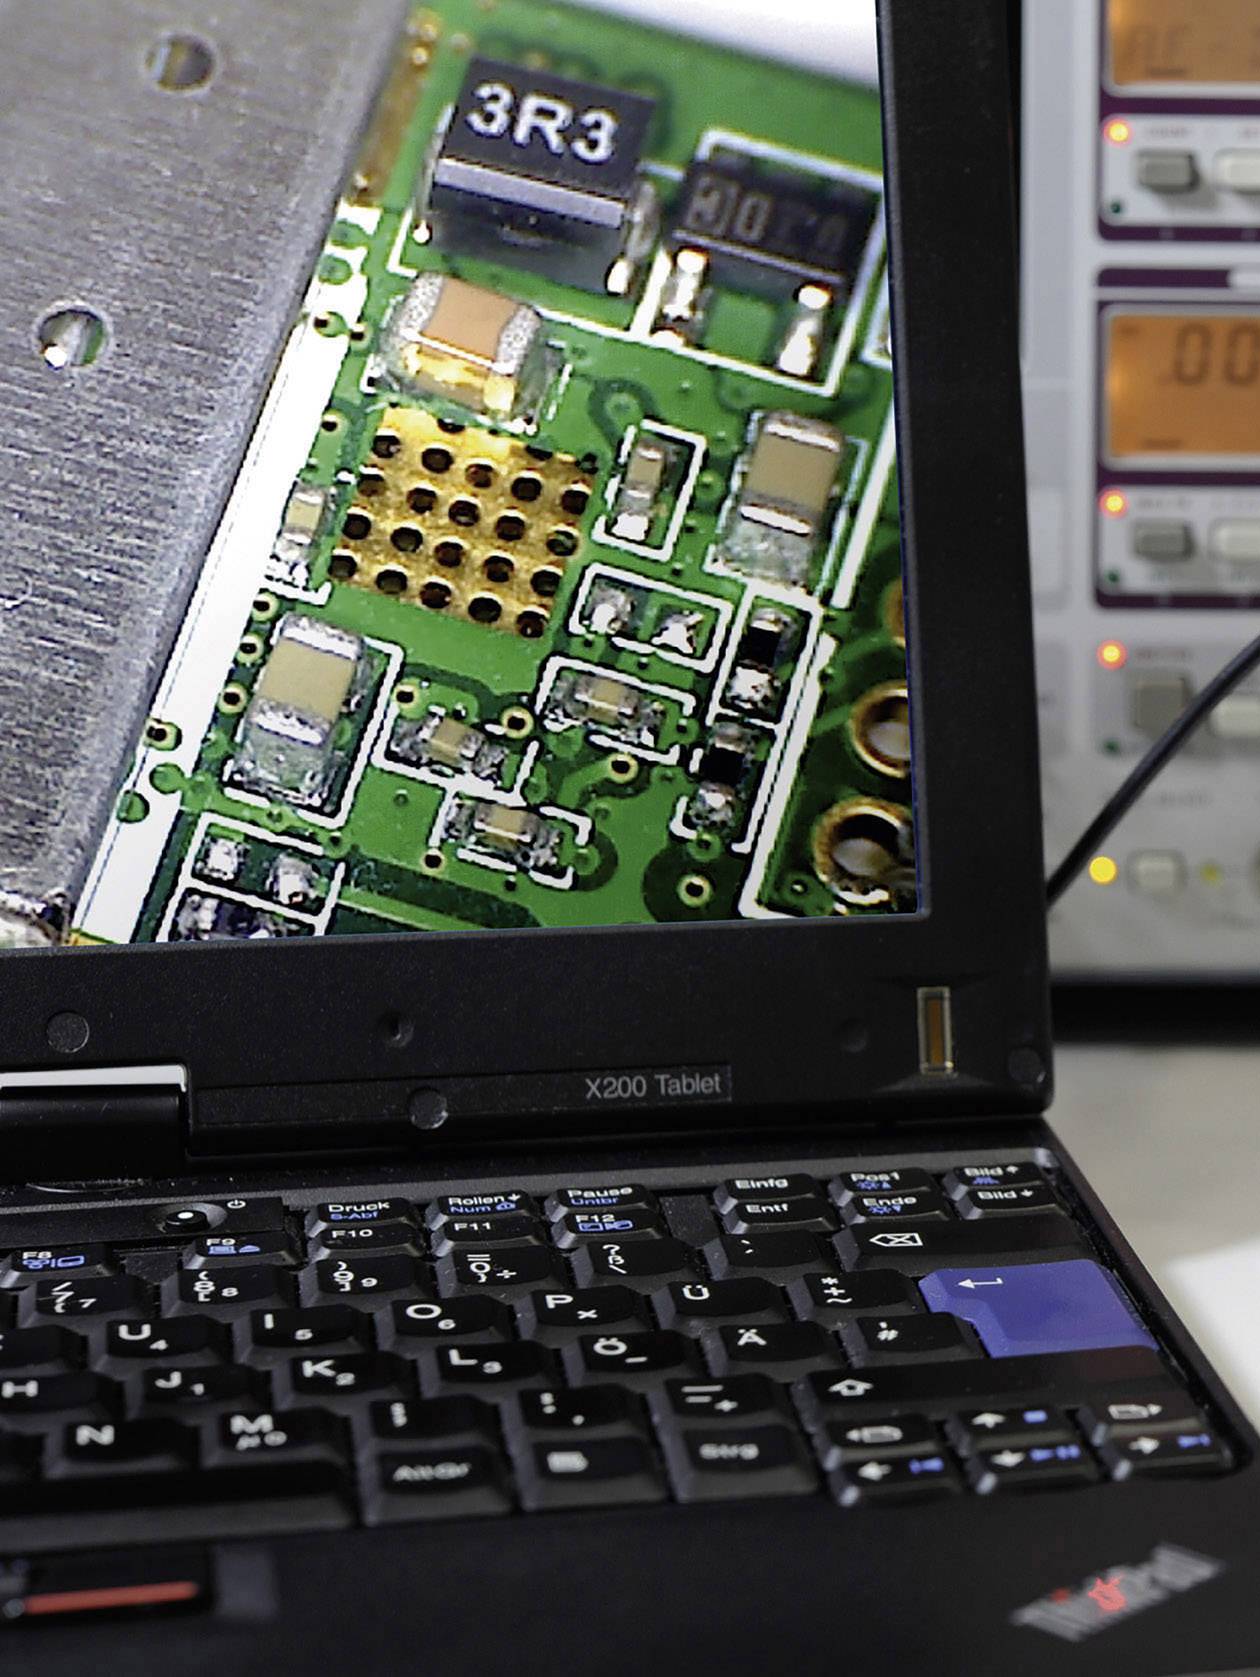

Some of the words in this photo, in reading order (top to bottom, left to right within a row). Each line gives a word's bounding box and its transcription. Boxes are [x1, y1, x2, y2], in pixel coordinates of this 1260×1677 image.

[465, 83, 618, 164] 3R3
[585, 1075, 647, 1100] X200
[654, 1072, 721, 1097] Tablet
[851, 1172, 899, 1183] Pos1
[964, 1166, 1003, 1177] Bild
[735, 1178, 789, 1189] Einfg
[567, 1186, 633, 1199] Pause
[977, 1190, 1018, 1200] Bild
[328, 1201, 390, 1213] Druck
[448, 1195, 505, 1206] Rollen
[745, 1203, 788, 1213] Entf
[863, 1196, 917, 1207] Ende
[450, 1205, 492, 1213] Num
[576, 1213, 616, 1223] F12
[331, 1228, 373, 1238] F10
[454, 1222, 491, 1231] F11
[682, 1284, 710, 1301] Ü
[545, 1294, 574, 1309] P
[405, 1303, 442, 1320] O
[118, 1323, 152, 1341] U
[737, 1328, 767, 1346] Ä
[593, 1337, 628, 1356] Ö
[449, 1348, 478, 1366] L
[302, 1359, 337, 1378] K
[155, 1370, 182, 1389] J
[1, 1380, 39, 1398] H
[230, 1414, 274, 1434] M
[76, 1424, 115, 1446] N
